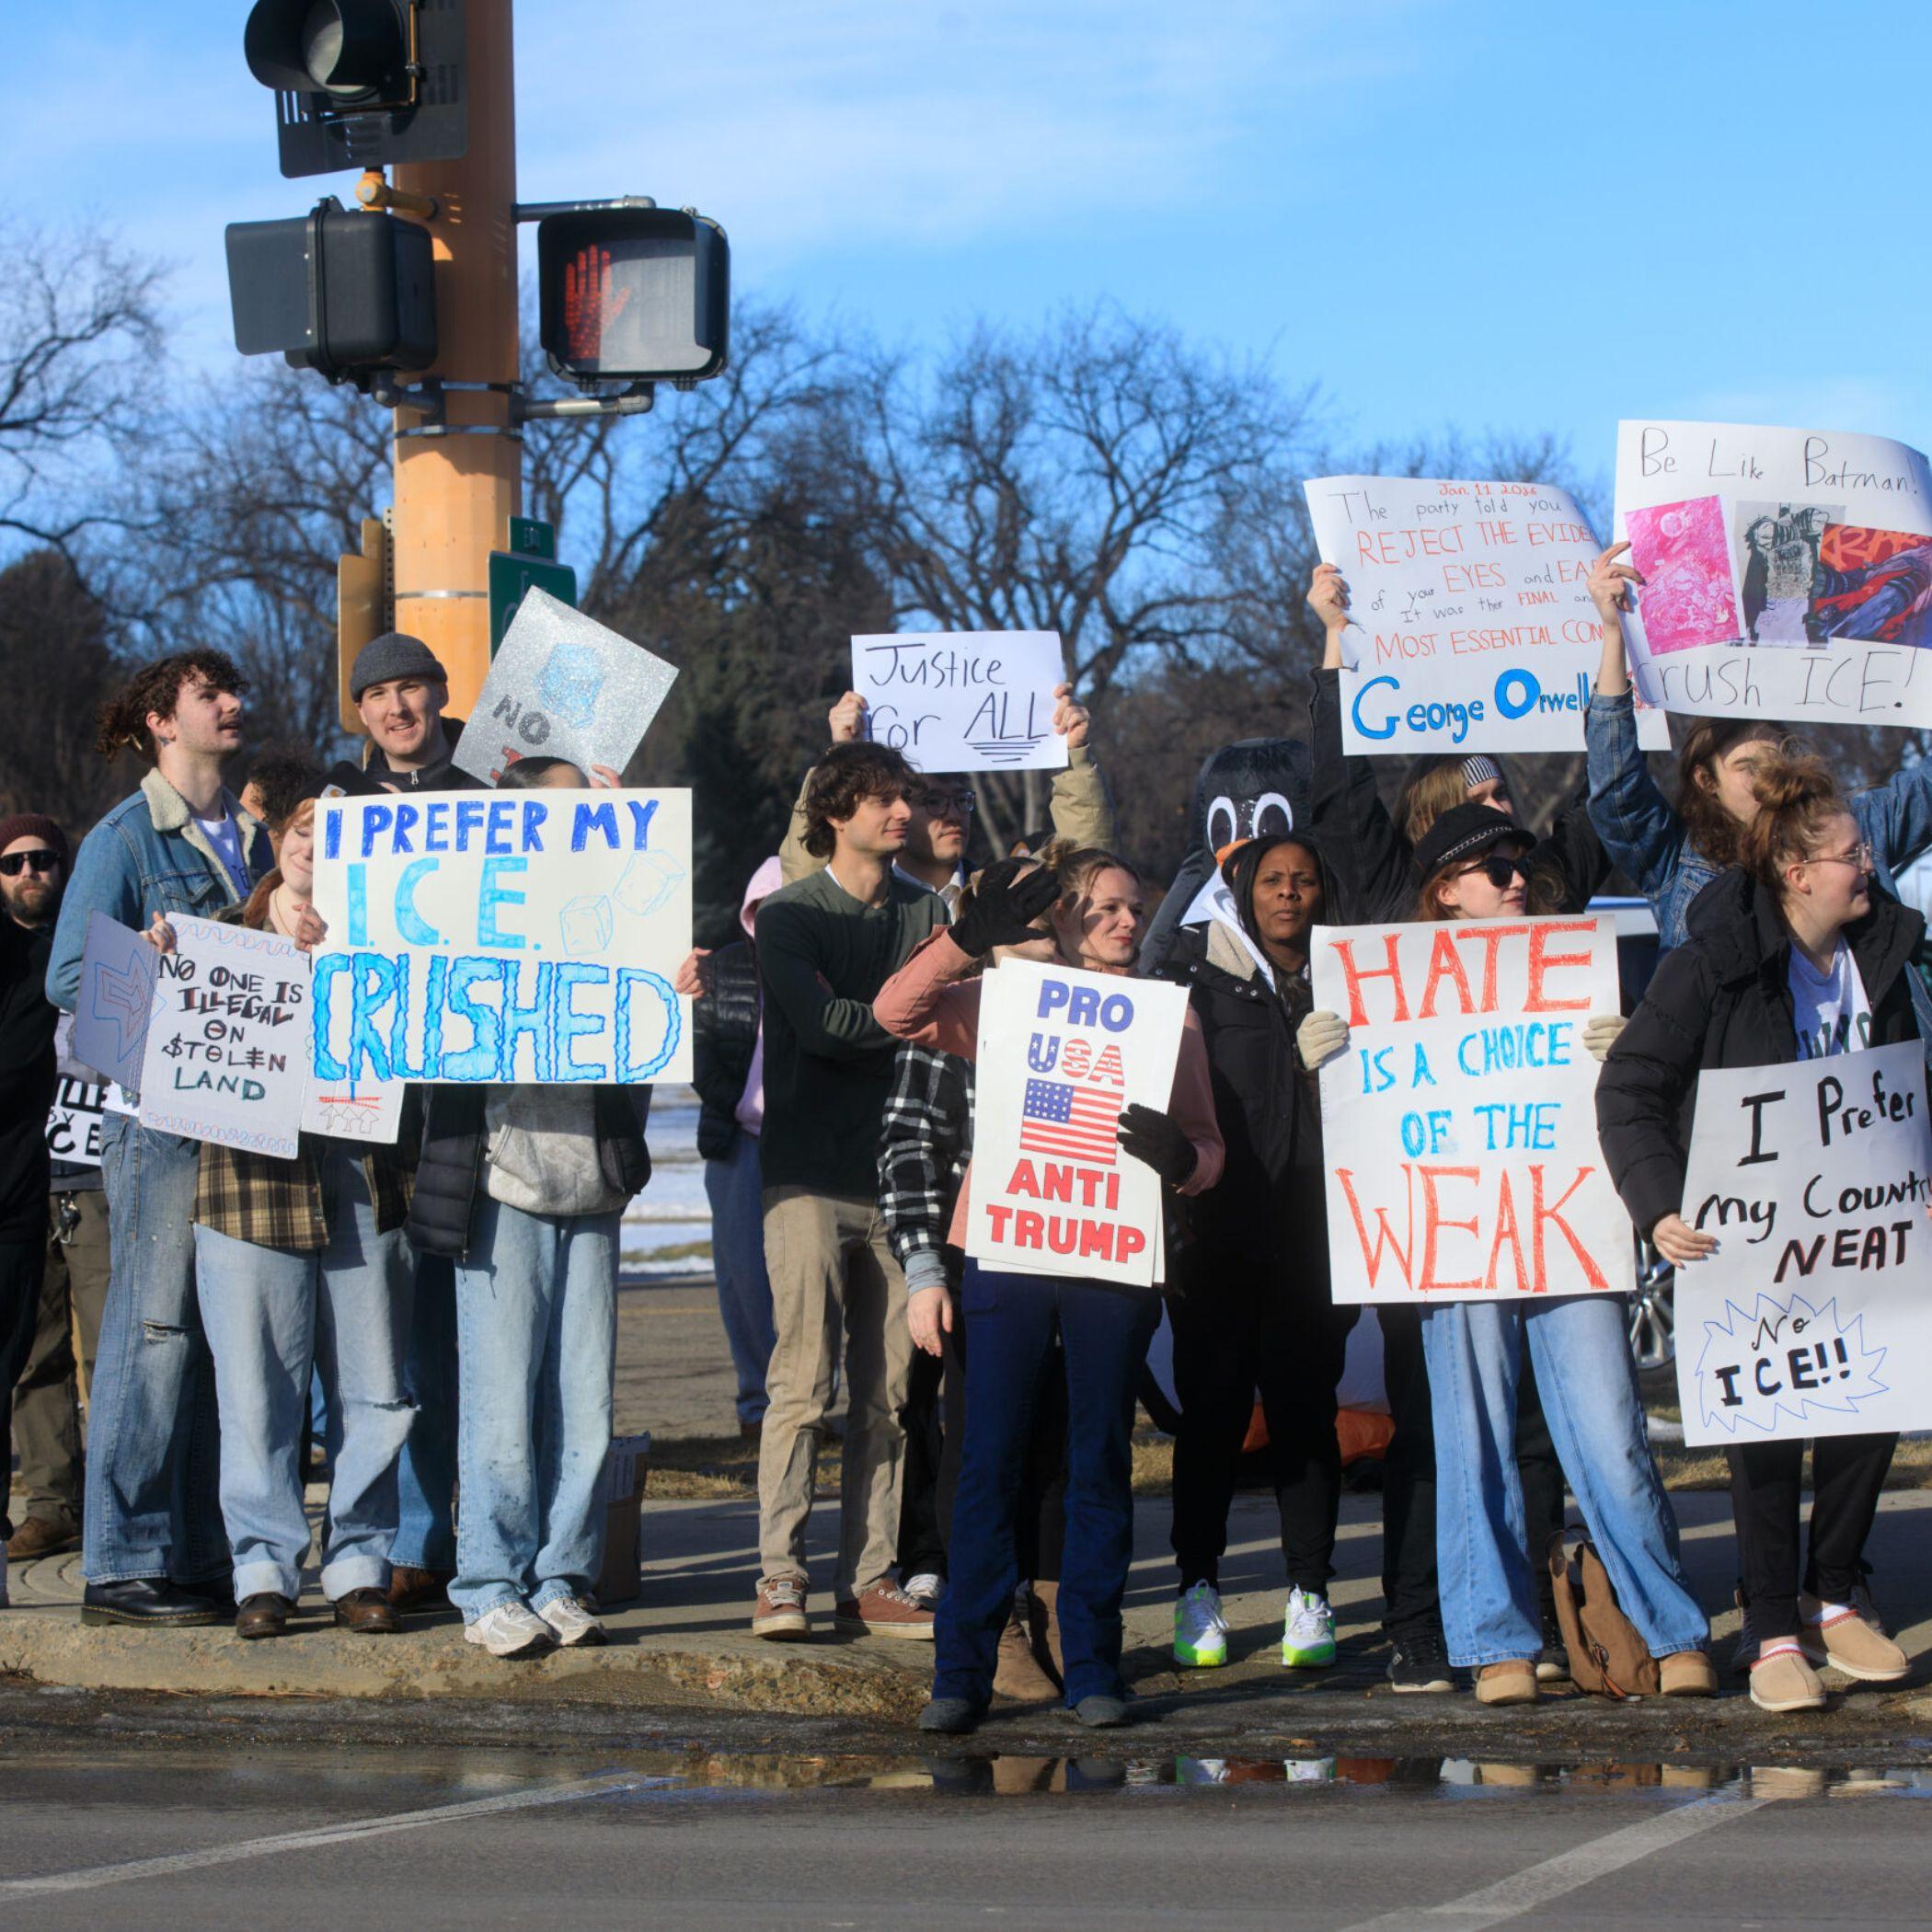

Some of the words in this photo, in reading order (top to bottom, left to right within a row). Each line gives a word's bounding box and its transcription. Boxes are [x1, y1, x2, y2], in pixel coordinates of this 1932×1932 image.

[1640, 427, 1678, 477] Be
[1708, 438, 1765, 479] Like
[1804, 436, 1919, 495] Batman!
[1327, 489, 1389, 523] The
[1415, 499, 1459, 522] party
[1474, 495, 1509, 515] told
[1528, 498, 1562, 514] you
[1355, 524, 1465, 568] REJECT
[1475, 520, 1518, 546] THE
[1370, 590, 1386, 612] of
[1442, 562, 1507, 593] EYES
[1524, 563, 1555, 586] and
[1400, 610, 1422, 624] It
[1433, 605, 1465, 620] was
[1518, 592, 1559, 605] FINAL
[865, 642, 1006, 689] Justice
[1374, 631, 1440, 664] MOST
[1451, 625, 1558, 655] ESSENTIAL
[1351, 675, 1485, 743] George
[1494, 668, 1591, 719] Orwell
[1795, 646, 1918, 714] ICE!
[492, 694, 552, 746] NO
[962, 691, 1049, 740] ALL
[324, 809, 343, 859] I
[361, 800, 549, 857] PREFER
[571, 799, 661, 852] MY
[346, 857, 543, 951] I.C.E.
[158, 953, 196, 981] NO
[209, 966, 265, 992] ONE
[270, 981, 304, 1004] IS
[1328, 918, 1599, 1029] HATE
[177, 986, 293, 1027] ILLEGAL
[203, 1019, 245, 1043] ON
[312, 951, 683, 1085] CRUSHED
[1037, 979, 1134, 1032] PRO
[174, 1066, 266, 1101] LAND
[1027, 1032, 1125, 1087] USA
[1360, 1046, 1397, 1094] IS
[1411, 1041, 1437, 1089] A
[1457, 1022, 1573, 1076] CHOICE
[47, 1121, 102, 1156] CE
[1400, 1110, 1453, 1158] OF
[1473, 1103, 1561, 1150] THE
[1737, 1089, 1786, 1167] I
[1818, 1070, 1915, 1146] Prefer
[1006, 1159, 1121, 1211] ANTI
[985, 1203, 1145, 1264] TRUMP
[1335, 1164, 1609, 1293] WEAK
[1774, 1220, 1913, 1283] NEAT
[1715, 1337, 1851, 1408] ICE!!
